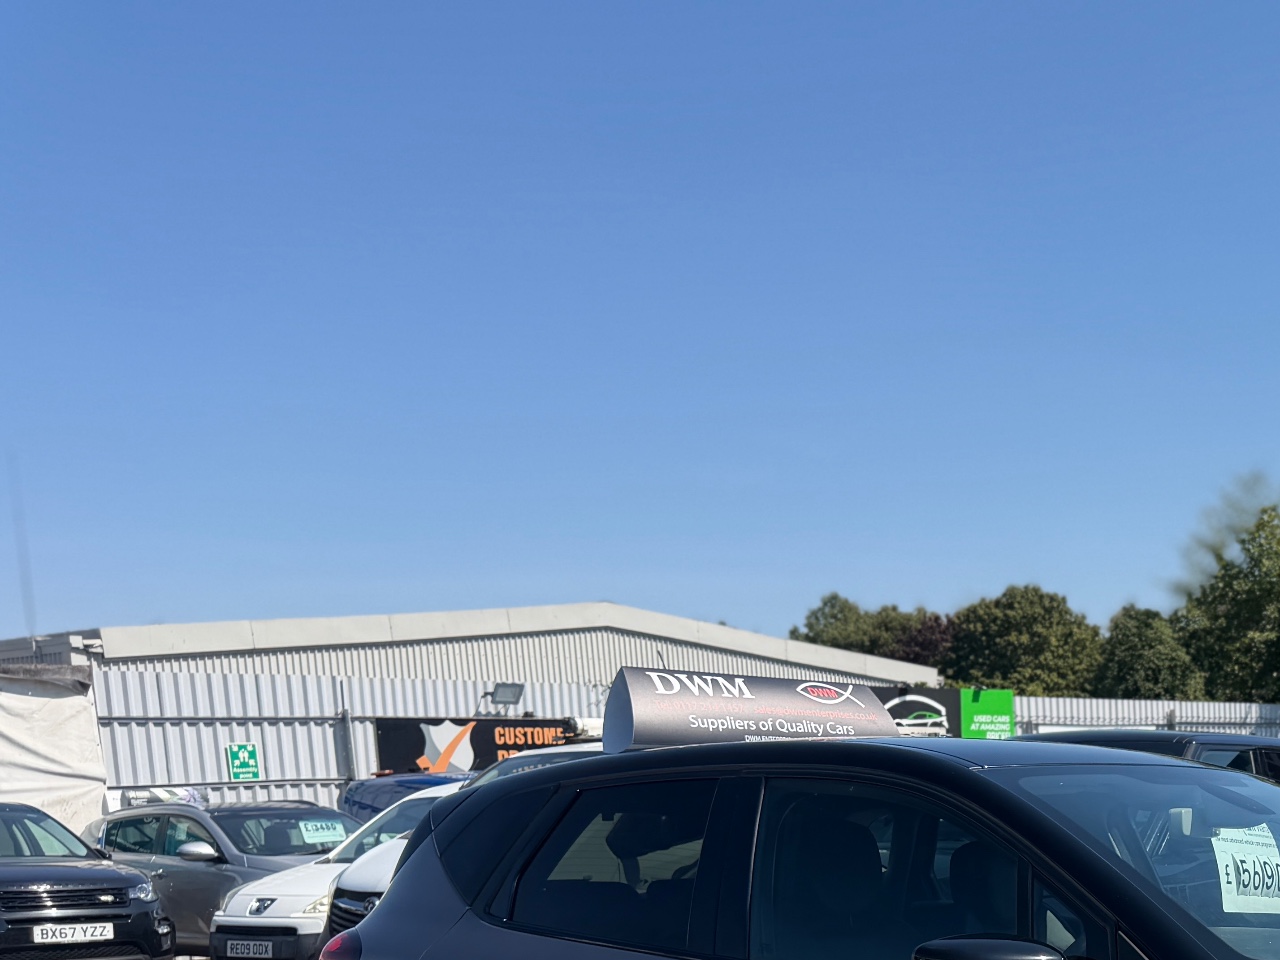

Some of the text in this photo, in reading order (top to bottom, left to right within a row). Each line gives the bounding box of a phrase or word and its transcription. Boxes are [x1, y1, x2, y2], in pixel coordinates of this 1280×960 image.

[645, 671, 755, 699] DWM
[807, 687, 838, 699] DWM
[754, 705, 878, 720] sales@dwmenterprises.co.uk
[973, 714, 1010, 723] USED CARS
[688, 715, 855, 737] Suppliers of Quality Cars
[970, 723, 1011, 731] AT AMAZING
[494, 726, 575, 745] CUSTOME
[40, 925, 108, 940] BX67 YZZ
[229, 942, 251, 955] RE09
